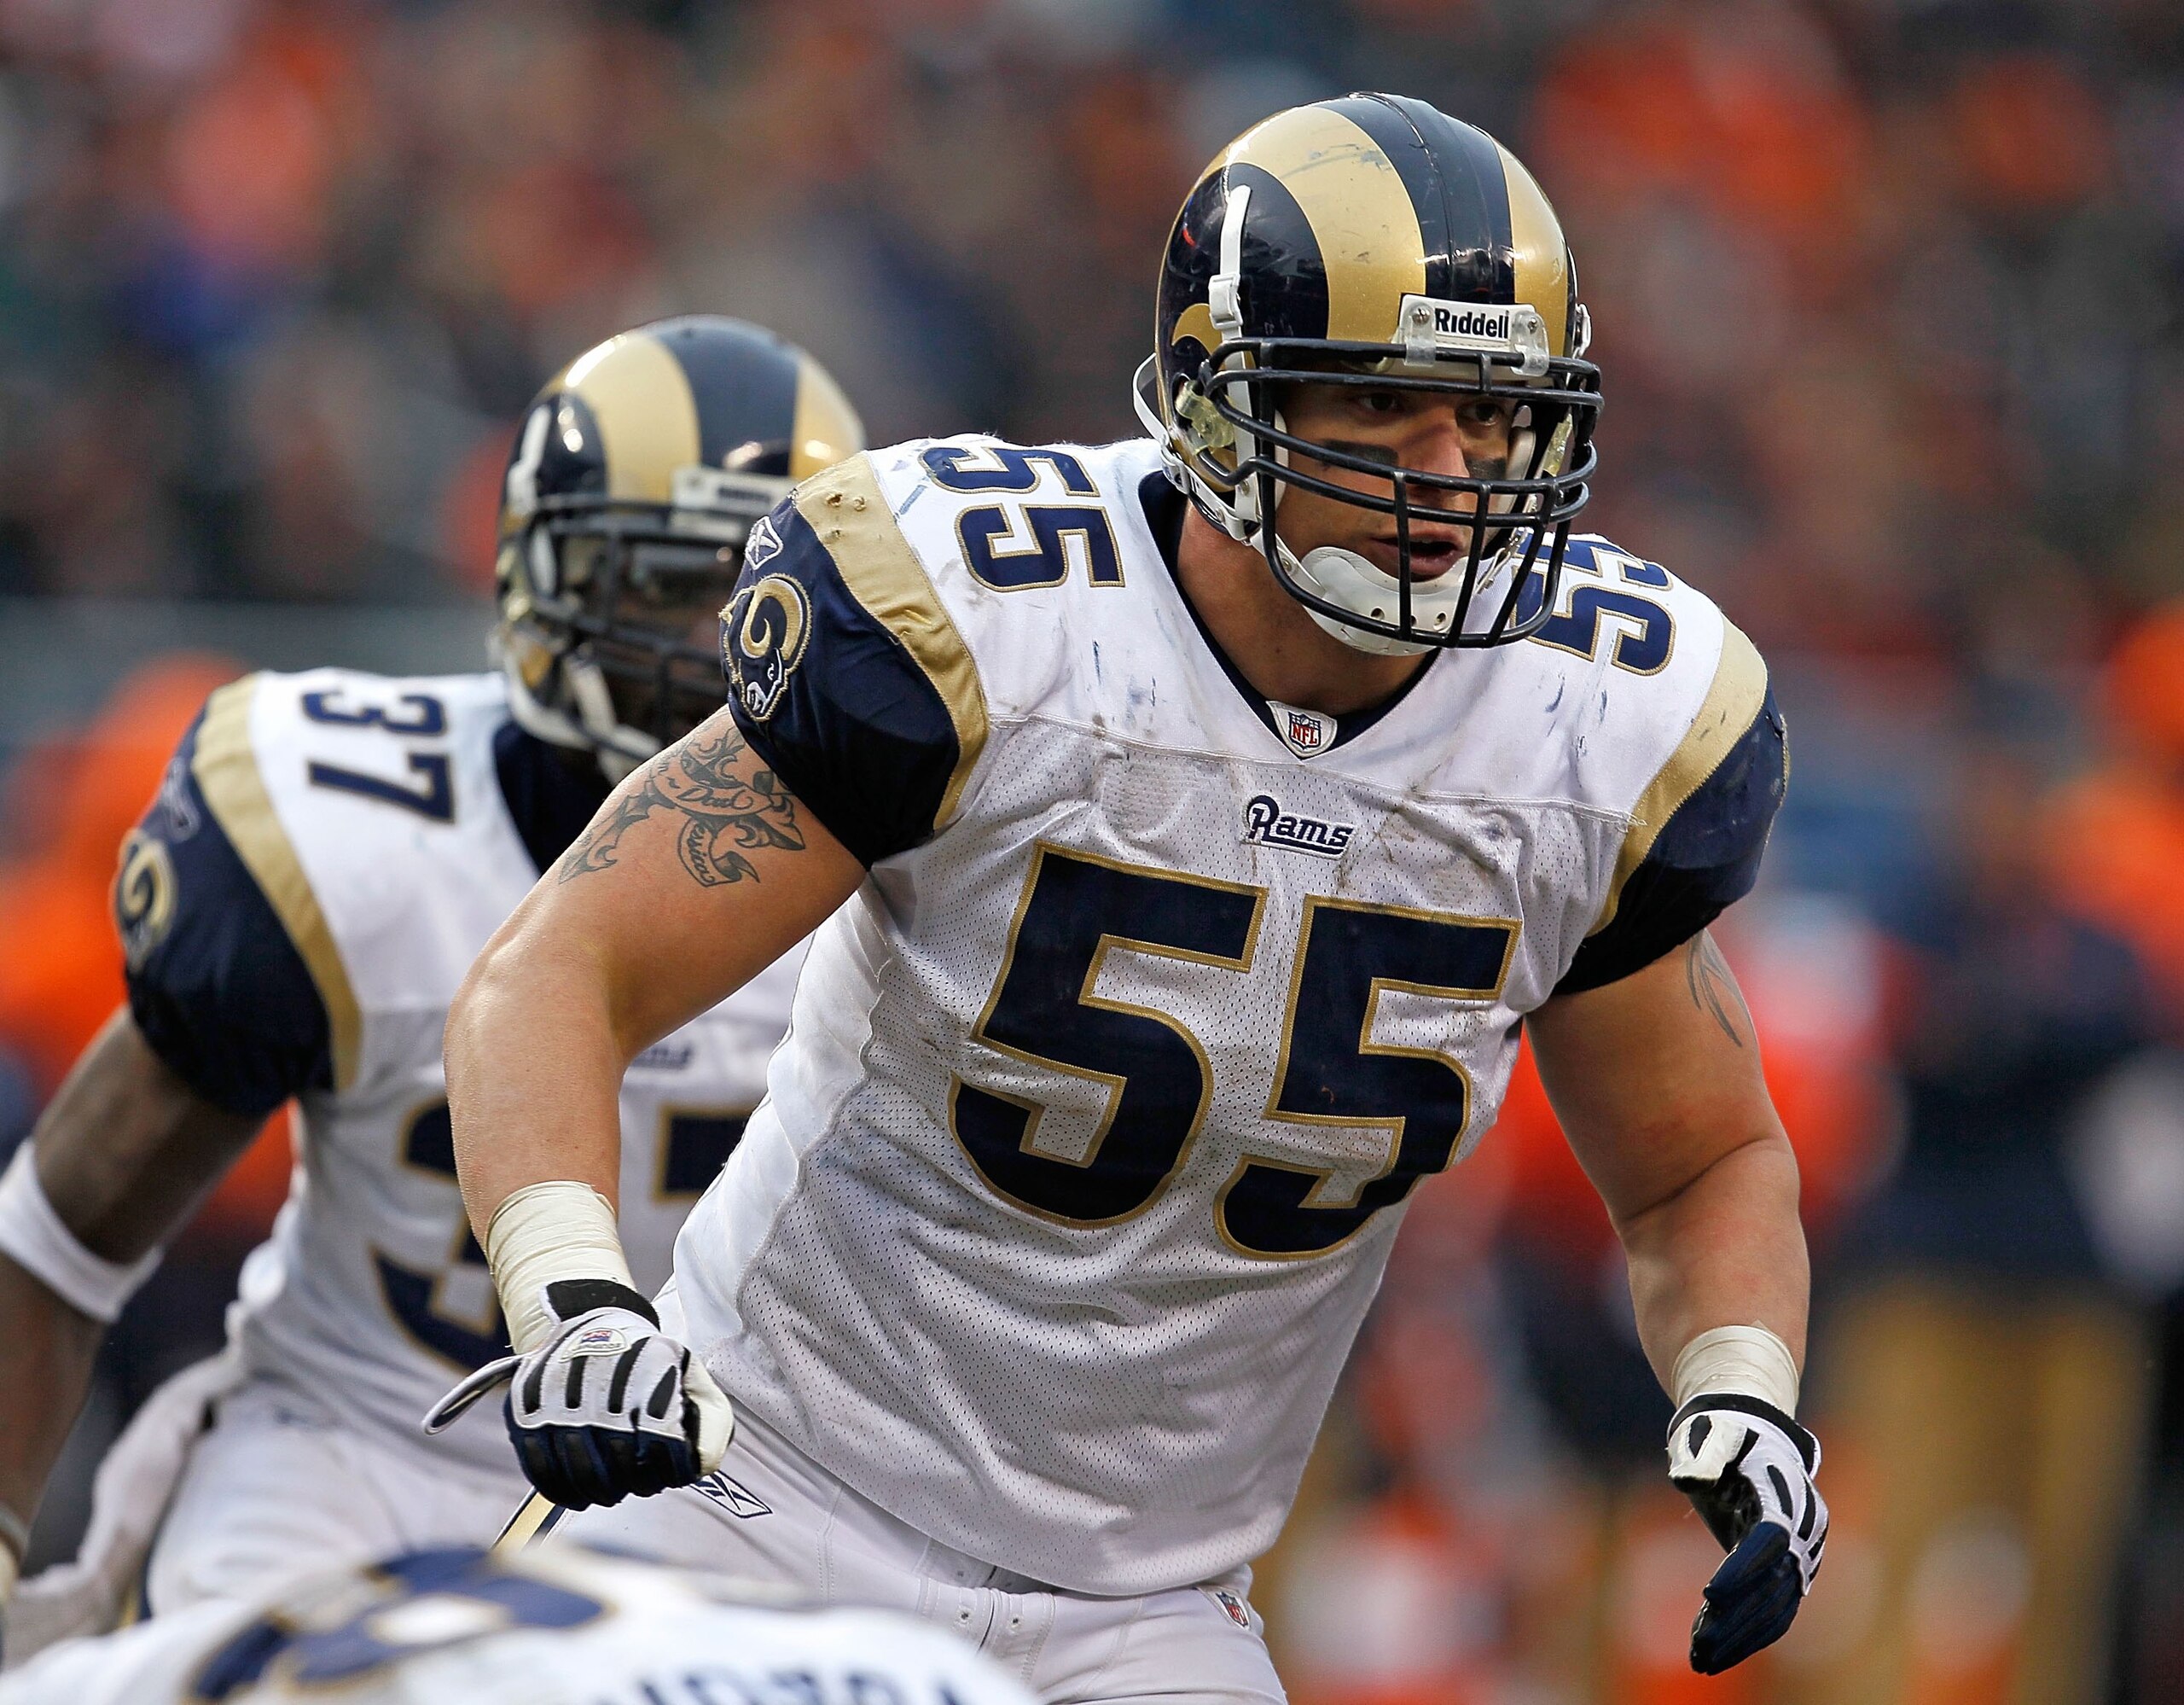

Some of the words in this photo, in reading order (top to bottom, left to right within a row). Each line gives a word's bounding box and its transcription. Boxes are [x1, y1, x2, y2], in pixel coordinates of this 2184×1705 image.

[1434, 307, 1510, 339] Riddell
[918, 447, 1125, 592] 55
[1509, 527, 1676, 676] 55
[300, 690, 456, 824] 37
[1290, 723, 1318, 745] NFL
[1246, 794, 1354, 847] Rams
[948, 841, 1522, 1261] 55
